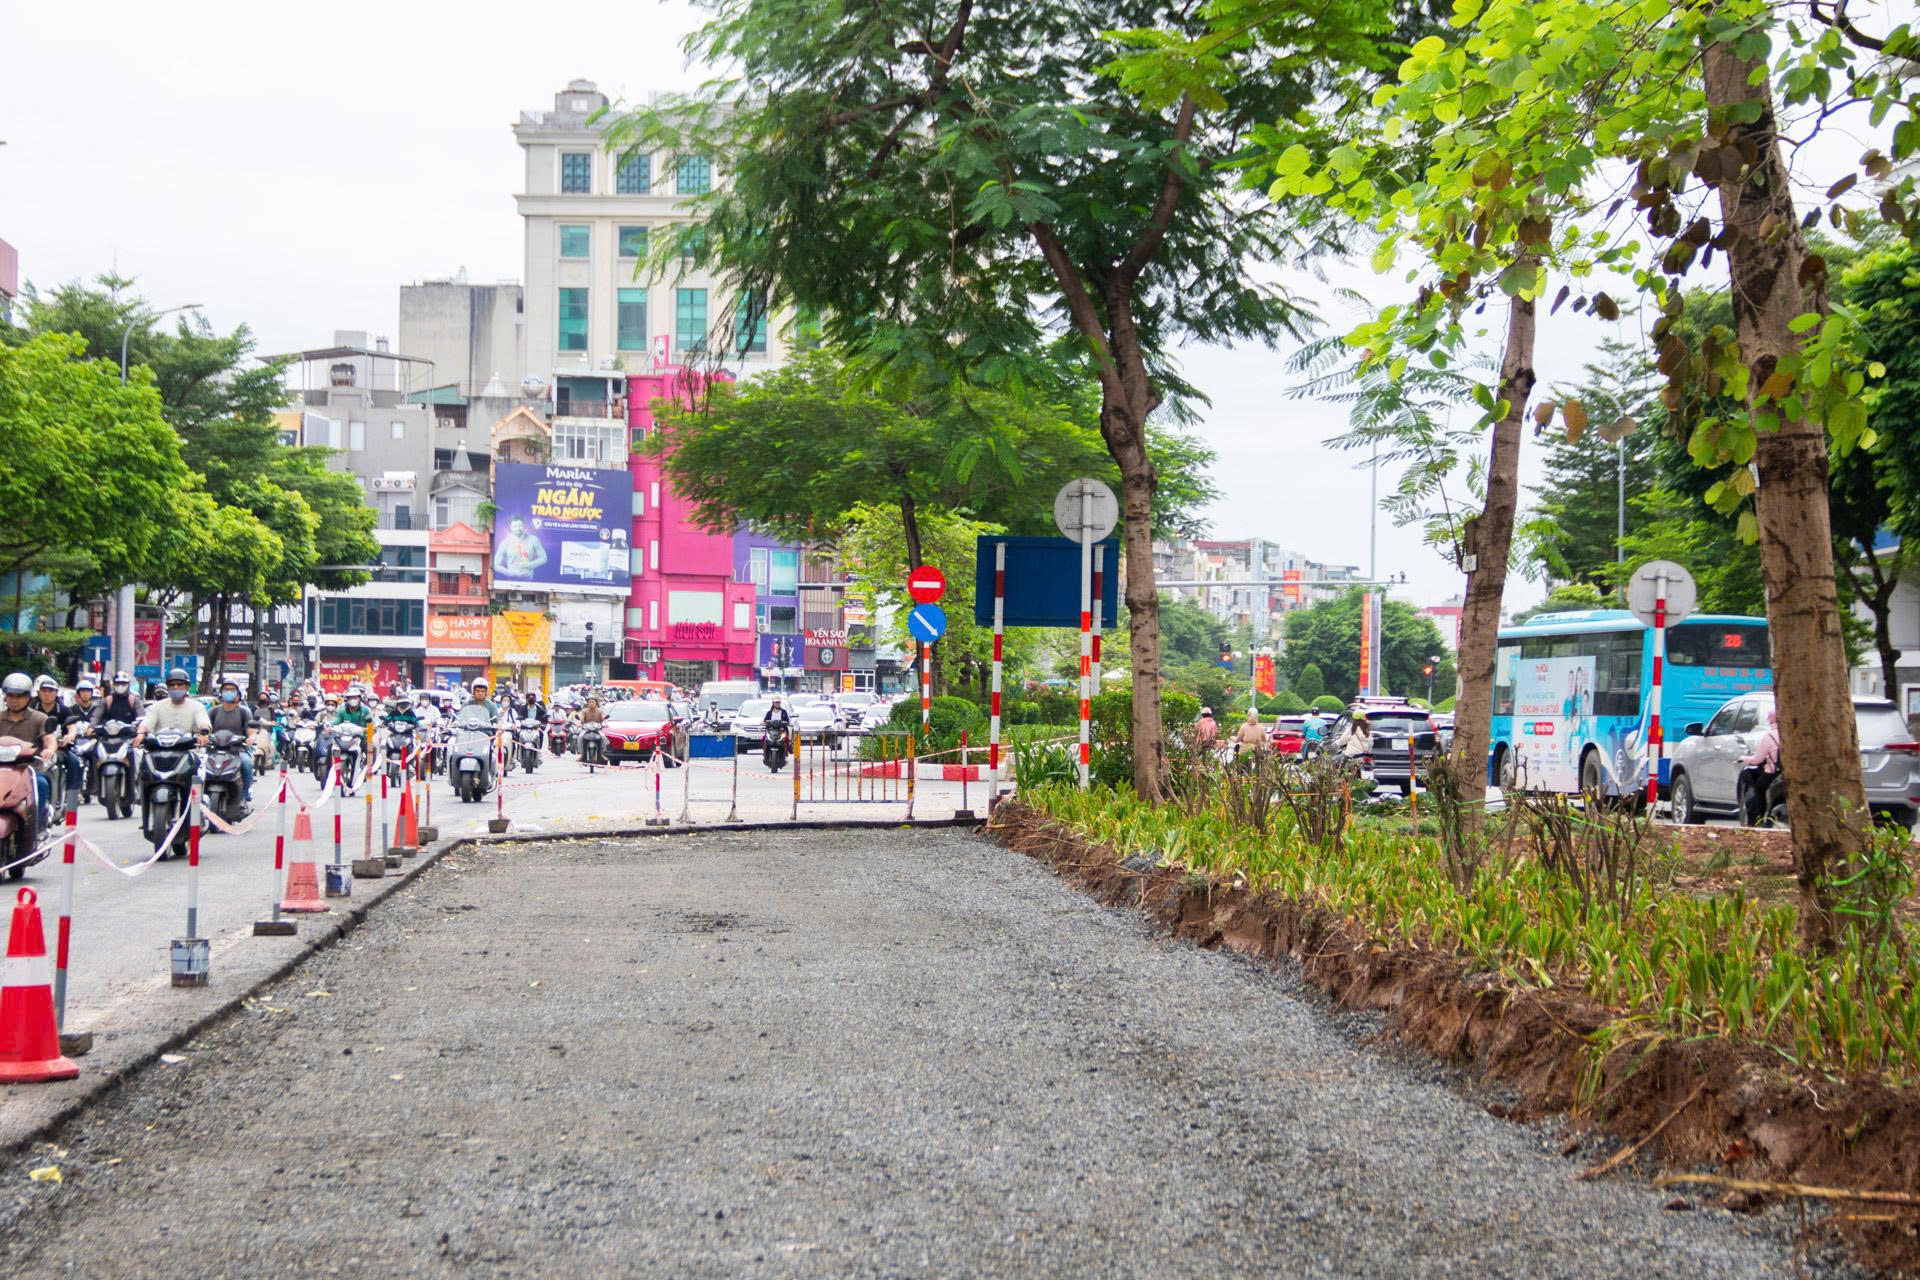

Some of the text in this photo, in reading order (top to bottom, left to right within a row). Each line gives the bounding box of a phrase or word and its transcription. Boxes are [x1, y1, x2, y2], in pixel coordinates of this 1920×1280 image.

[537, 488, 594, 507] NGĂN
[531, 504, 603, 521] TRÀO NGƯỢC
[450, 619, 488, 628] HAPPY
[450, 630, 488, 640] MONEY
[813, 627, 845, 638] YẾN SÀO
[182, 656, 189, 667] P
